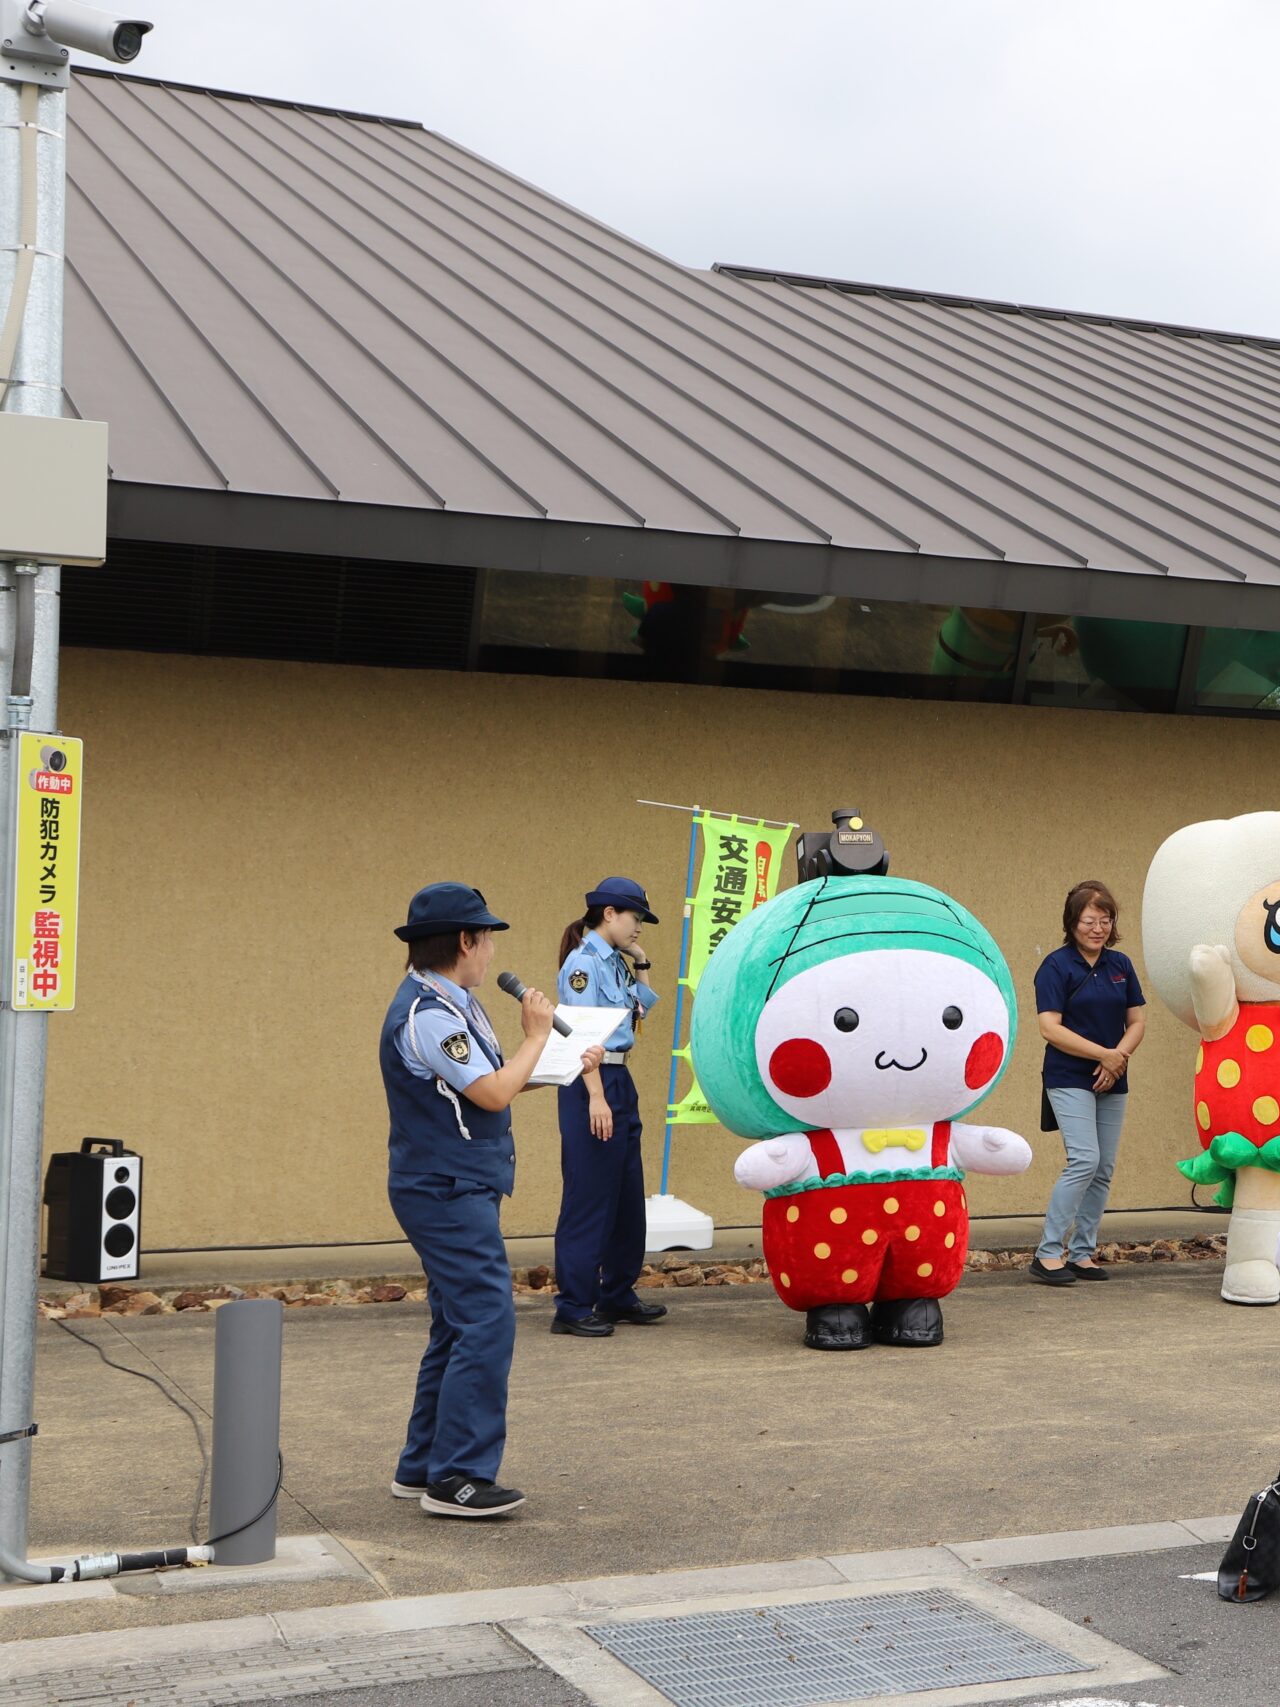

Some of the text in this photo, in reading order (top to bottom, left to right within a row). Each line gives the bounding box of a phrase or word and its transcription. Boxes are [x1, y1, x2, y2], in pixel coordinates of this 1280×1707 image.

[37, 774, 72, 791] 作動中
[39, 797, 60, 904] 防犯カメラ
[840, 834, 871, 842] MOKAPYON
[33, 911, 60, 997] 監視中
